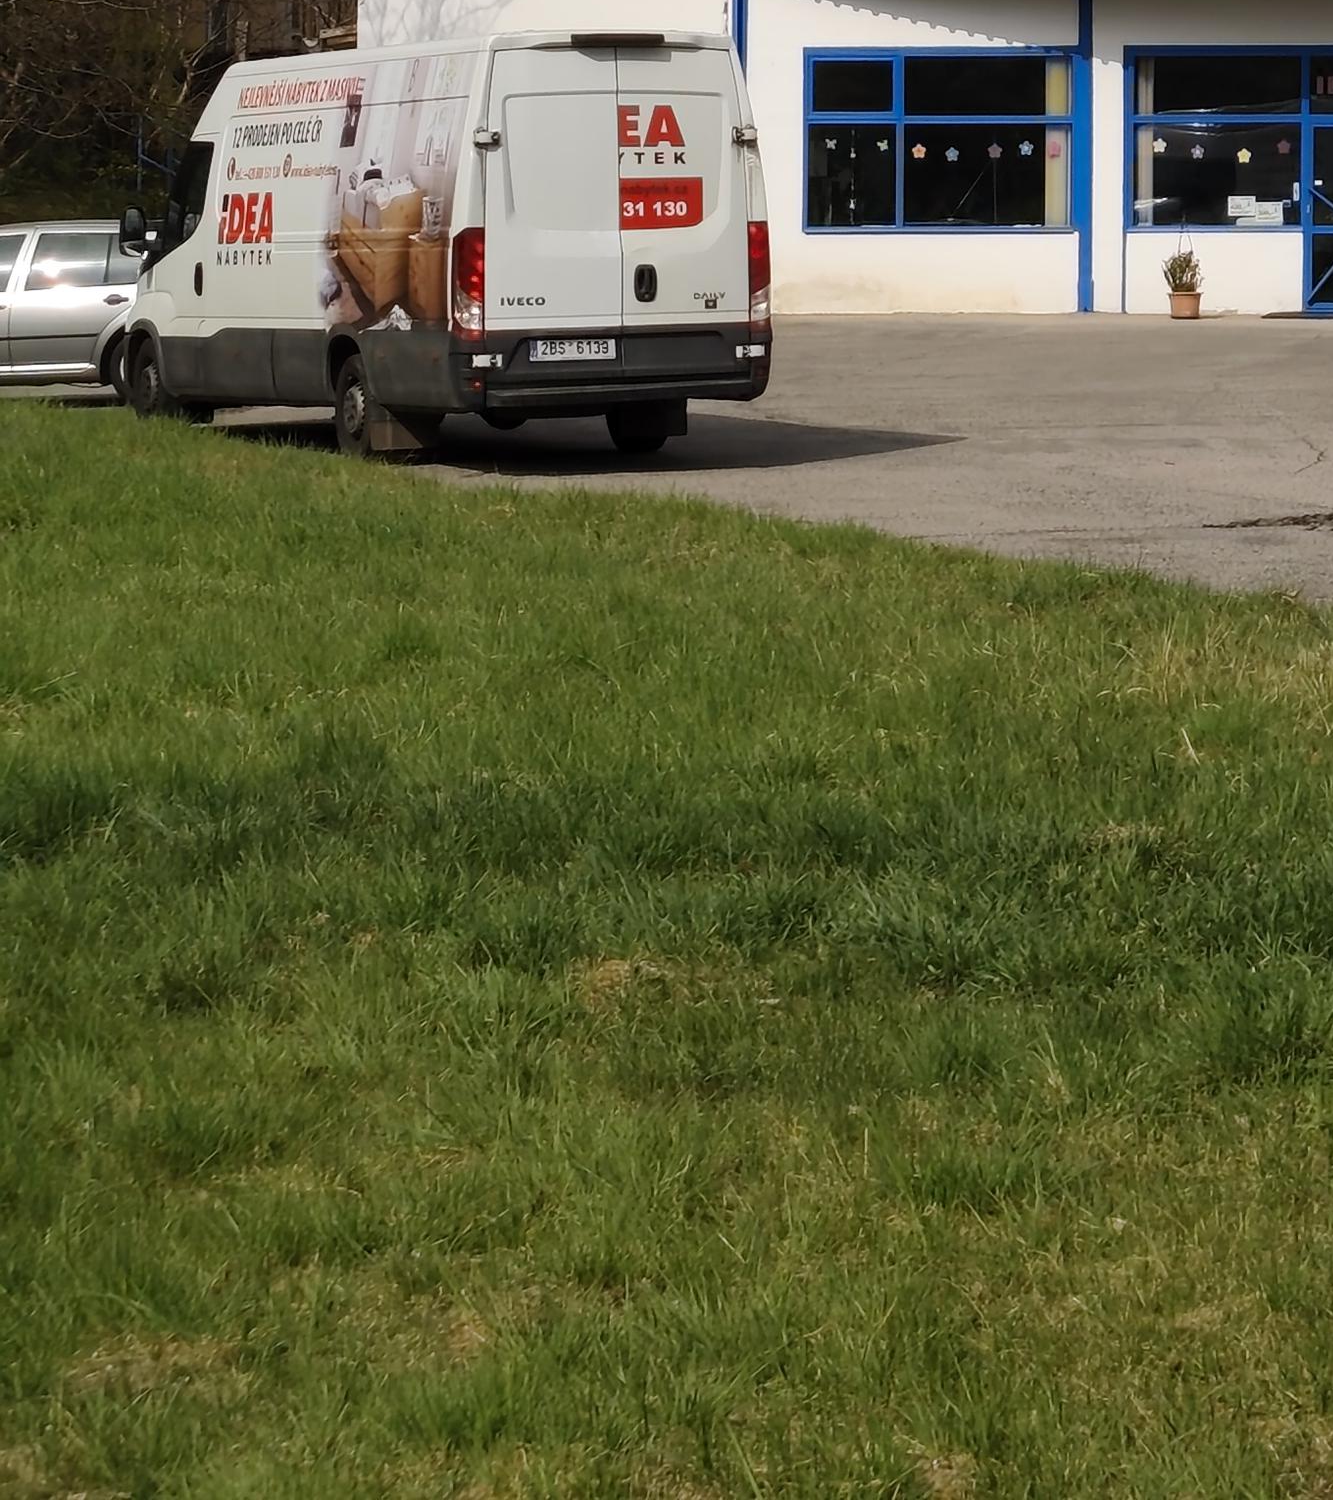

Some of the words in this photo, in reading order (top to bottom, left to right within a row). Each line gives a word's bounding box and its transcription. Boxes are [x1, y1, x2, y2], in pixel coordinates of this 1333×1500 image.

[617, 105, 685, 147] EA
[232, 127, 243, 148] 12
[241, 122, 282, 148] PRODEJEN
[280, 121, 294, 145] PO
[623, 201, 644, 217] 31
[652, 201, 687, 217] 130
[216, 247, 272, 266] NÁBYTEK
[500, 297, 546, 306] IVECO
[693, 291, 726, 300] DAILY
[541, 341, 566, 355] 2BS
